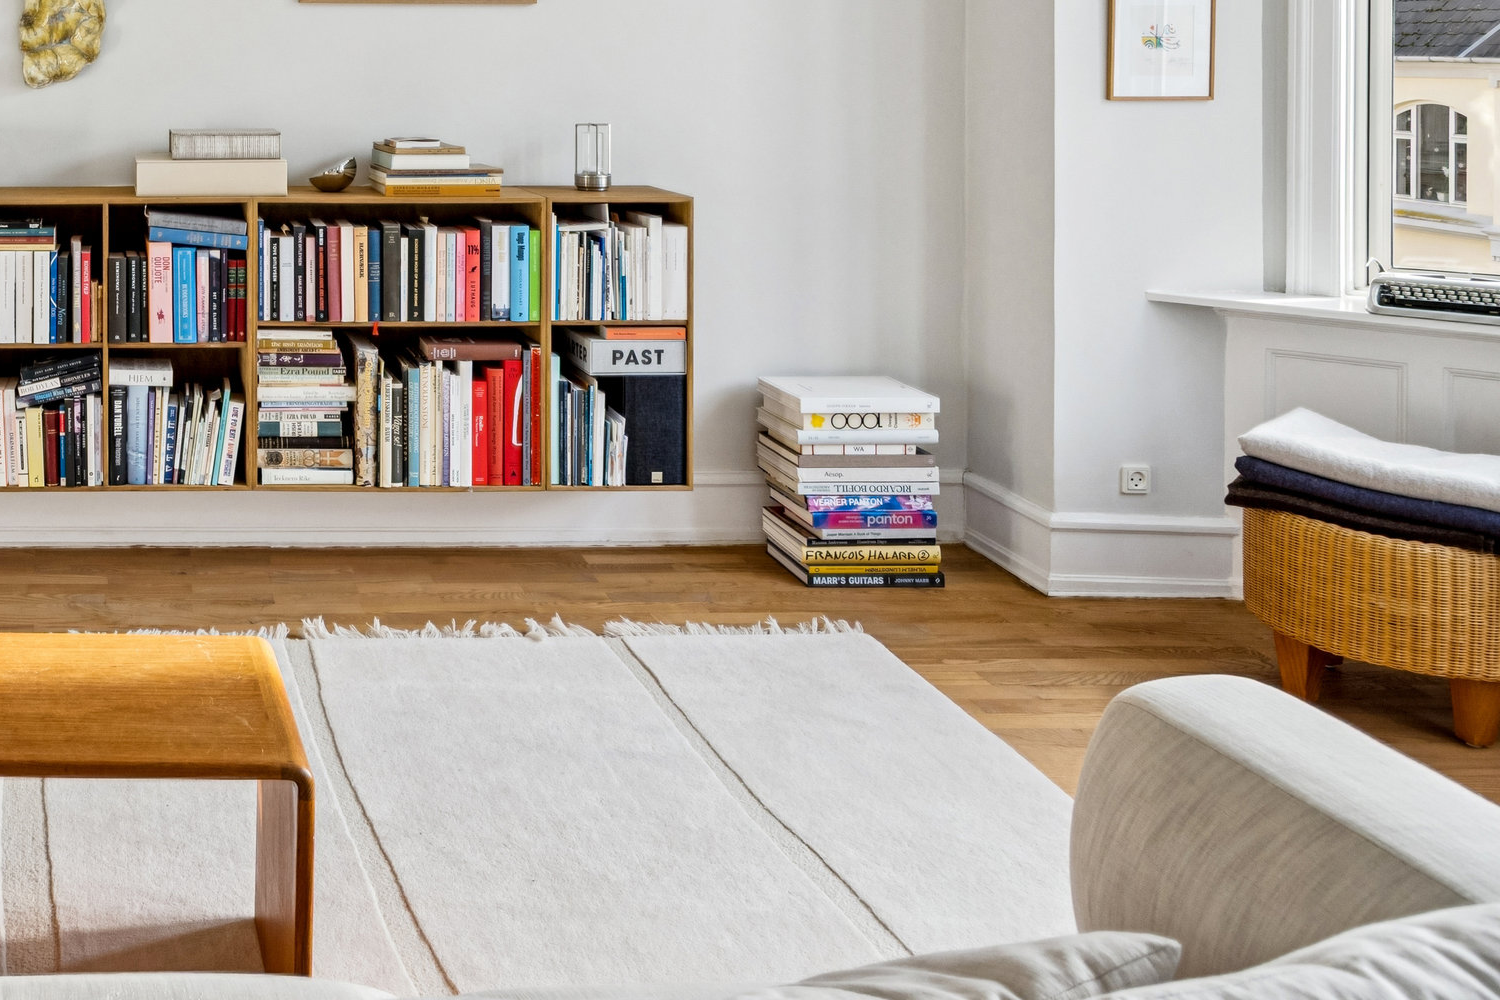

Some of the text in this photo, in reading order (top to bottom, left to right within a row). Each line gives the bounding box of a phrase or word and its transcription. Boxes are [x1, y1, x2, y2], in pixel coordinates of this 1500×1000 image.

[468, 245, 479, 255] 11%
[154, 256, 162, 283] QUIJOTE
[162, 257, 171, 270] DON
[612, 350, 664, 365] PAST
[280, 367, 300, 375] Ezra
[301, 367, 330, 376] Pound
[20, 373, 91, 394] BOB DYLAN CHRONICLES
[129, 375, 153, 383] HJEM
[114, 400, 123, 413] DAN
[392, 414, 403, 447] Våga se!
[8, 432, 17, 473] DRØMMEFILM
[813, 498, 847, 506] VERNER
[867, 514, 913, 527] panton
[805, 549, 865, 562] FRANÇOIS
[867, 549, 916, 561] HALARD
